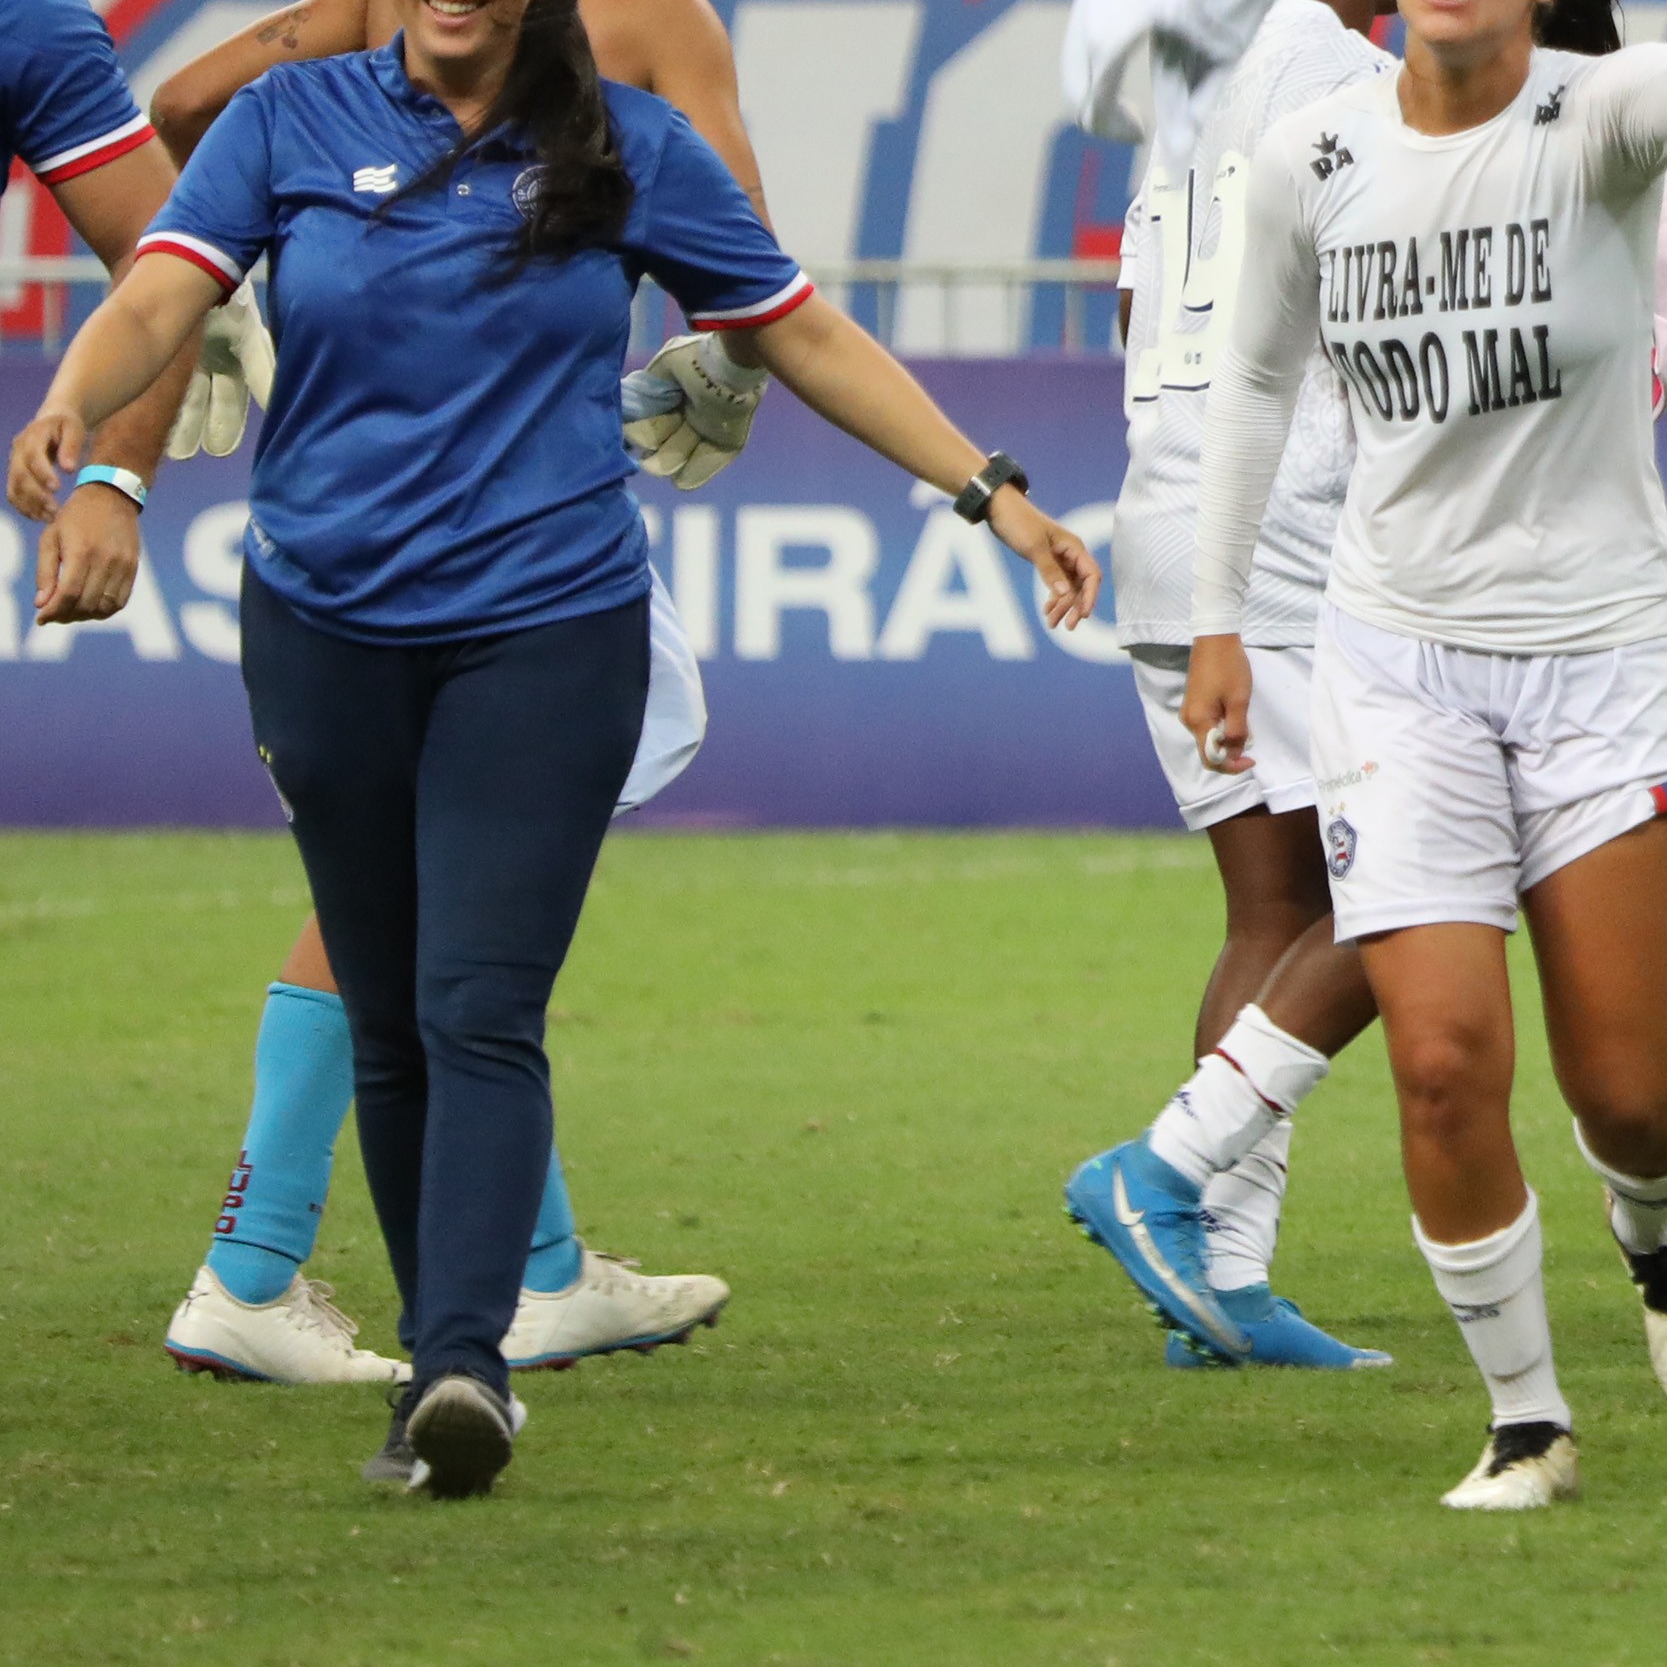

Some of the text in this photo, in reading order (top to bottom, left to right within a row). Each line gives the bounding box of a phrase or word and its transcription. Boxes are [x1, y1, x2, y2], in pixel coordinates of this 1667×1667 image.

[1309, 147, 1354, 182] RA
[1326, 217, 1552, 323] LIVRA-ME DE
[1330, 323, 1562, 424] TODO MAL
[214, 1149, 254, 1234] LUPO
